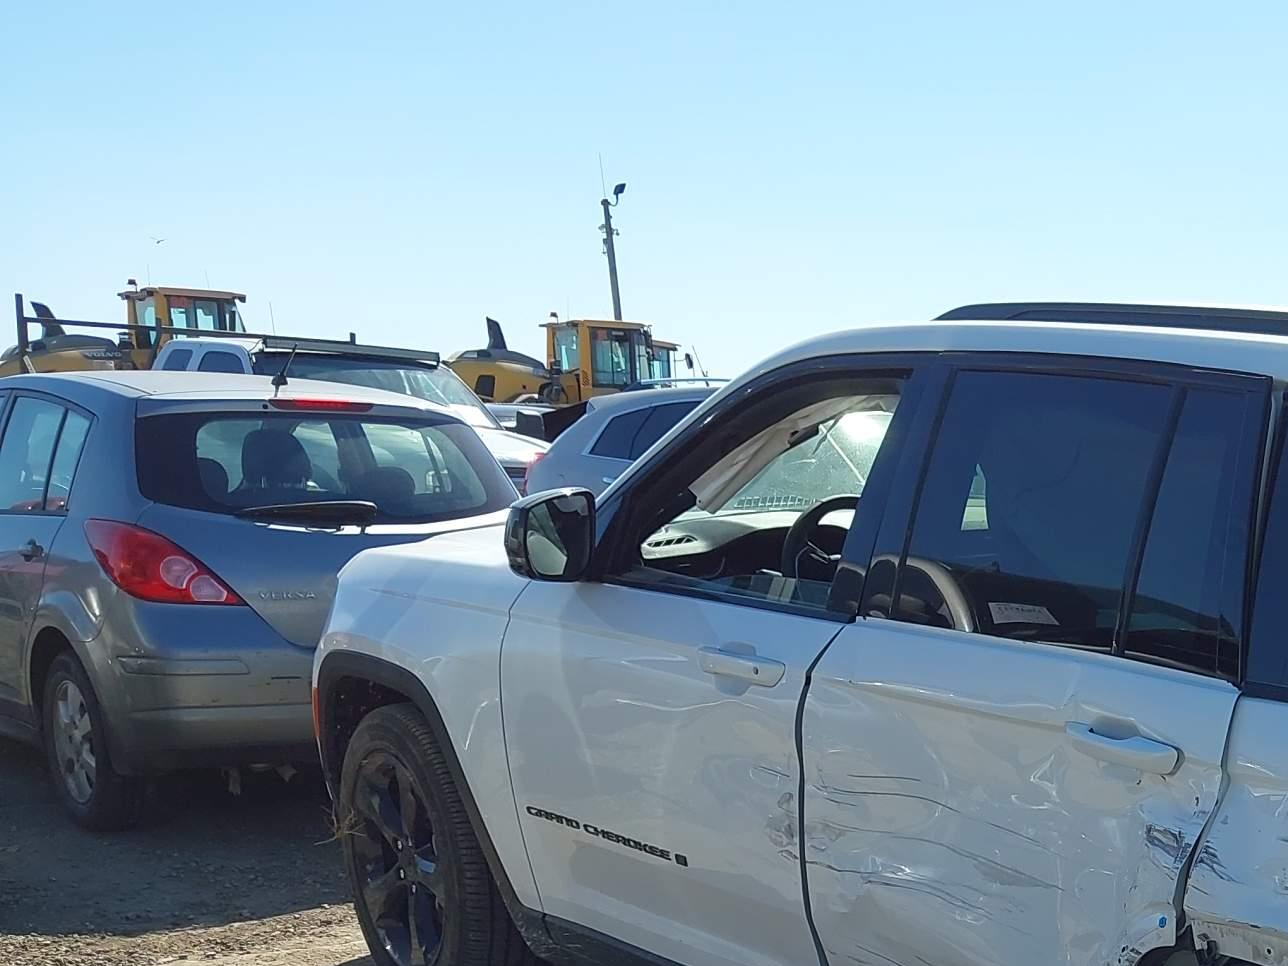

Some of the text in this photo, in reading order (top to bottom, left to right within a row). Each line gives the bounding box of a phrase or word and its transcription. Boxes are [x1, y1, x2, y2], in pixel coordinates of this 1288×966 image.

[259, 591, 317, 600] VERSA
[526, 806, 672, 861] GRAND CHEROKEE
